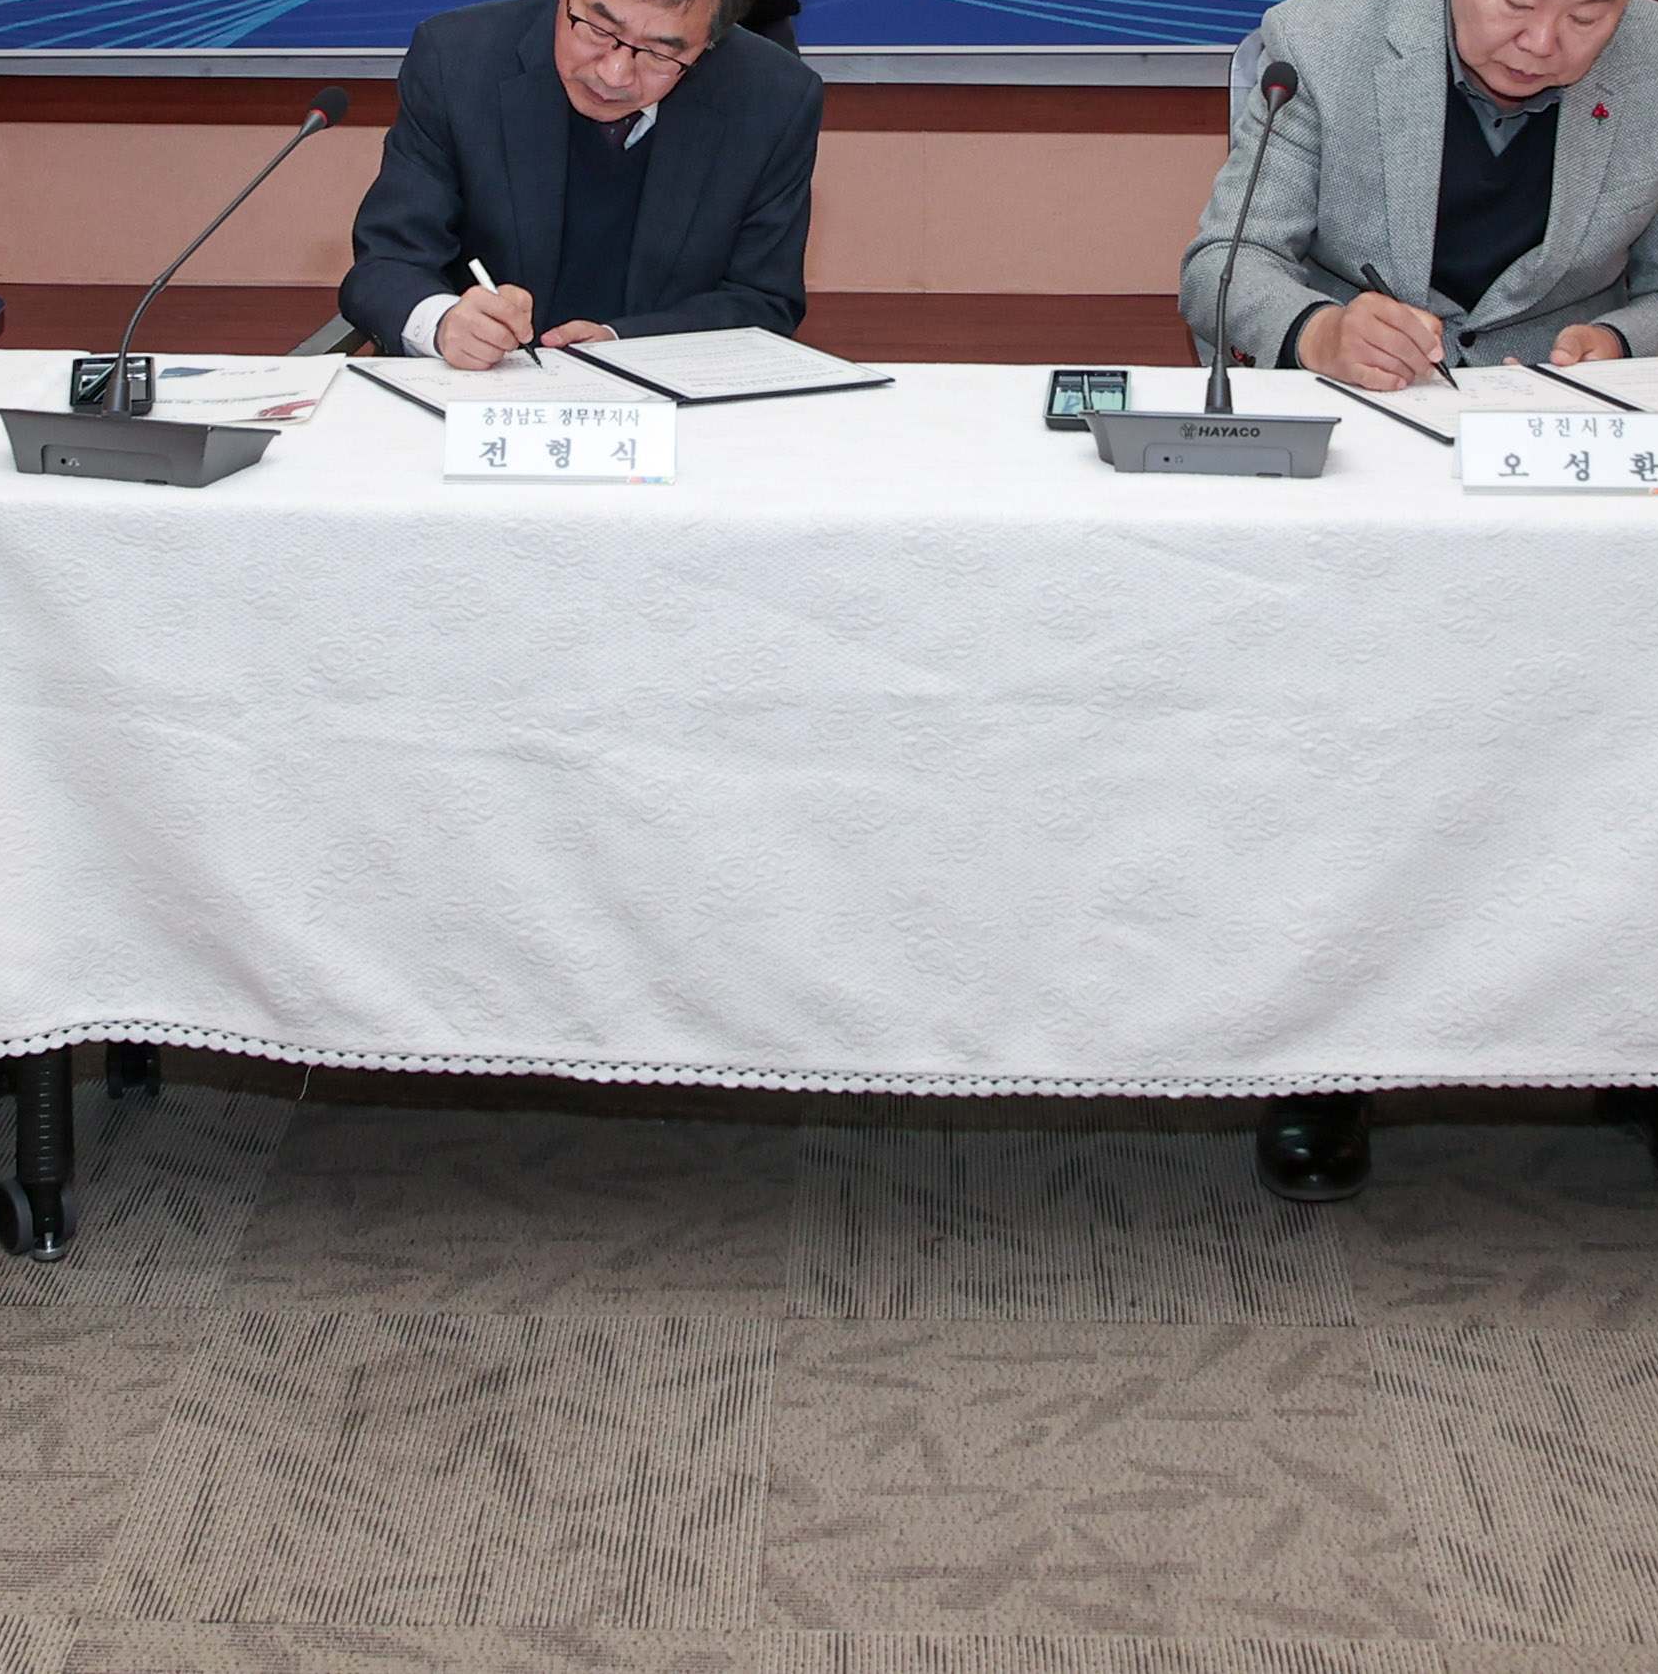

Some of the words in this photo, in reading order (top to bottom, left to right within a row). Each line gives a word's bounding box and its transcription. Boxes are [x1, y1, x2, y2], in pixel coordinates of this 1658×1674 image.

[482, 406, 548, 427] 충청남도
[558, 408, 641, 427] 정무부지사
[1198, 426, 1261, 439] HAYACO
